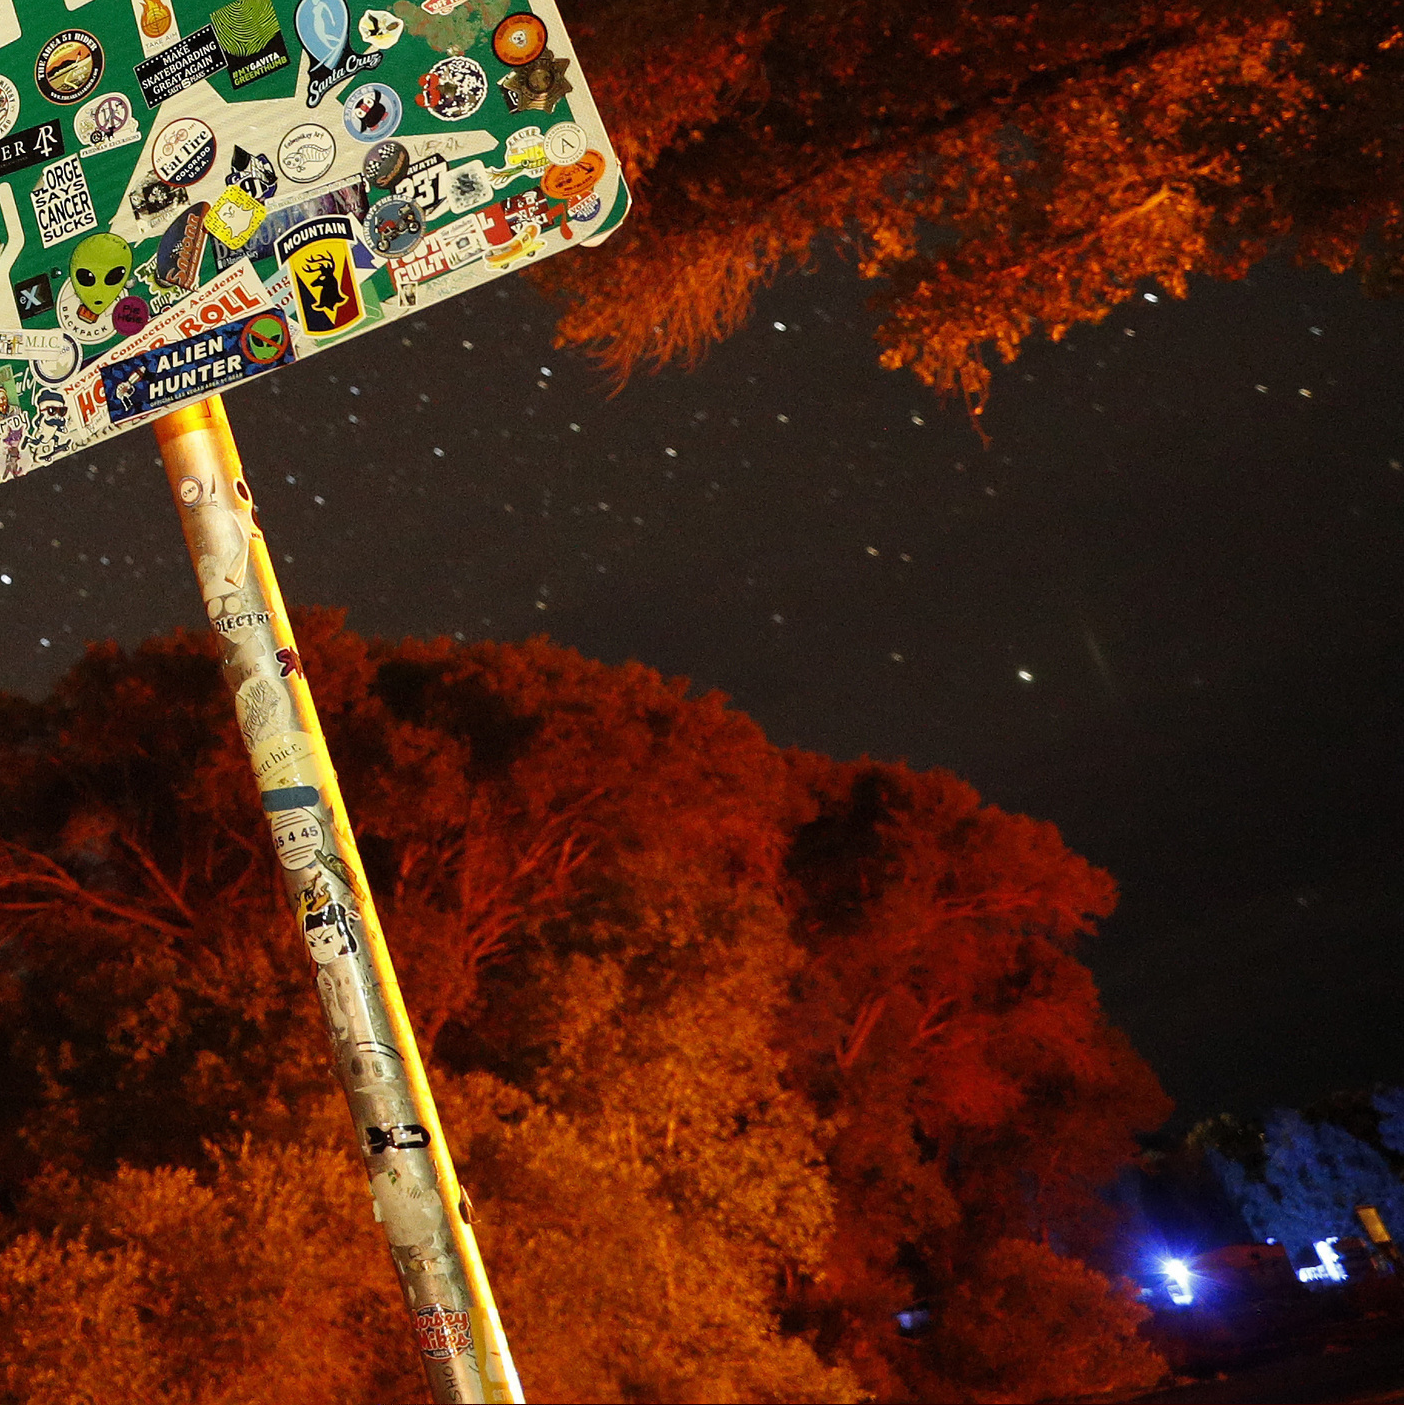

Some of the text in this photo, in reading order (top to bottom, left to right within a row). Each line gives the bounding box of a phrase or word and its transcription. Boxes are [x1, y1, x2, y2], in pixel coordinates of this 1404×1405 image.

[38, 33, 98, 81] THE AREA 51 RIDER
[141, 41, 217, 91] SKATEBOARDING
[162, 44, 191, 66] MAKE
[233, 56, 288, 87] GREENTHUMB
[152, 56, 214, 96] GREAT AGAIN
[308, 51, 383, 103] Santa Cruz
[160, 127, 209, 179] Fat Tire
[174, 145, 212, 182] COLORADO
[34, 178, 85, 210] SAYS
[570, 194, 597, 214] VOTED
[38, 196, 91, 231] CANCER
[43, 213, 95, 244] SUCKS
[283, 221, 348, 255] MOUNTAIN
[394, 256, 447, 288] CULT
[61, 305, 109, 339] BACKPACK
[176, 282, 266, 342] ROLL
[64, 359, 110, 395] Nevada
[110, 306, 187, 362] Connections
[188, 266, 246, 309] Academy
[156, 336, 224, 374] ALIEN
[148, 354, 242, 400] HUNTER
[288, 825, 319, 843] 4 45
[412, 1310, 470, 1332] Jersey
